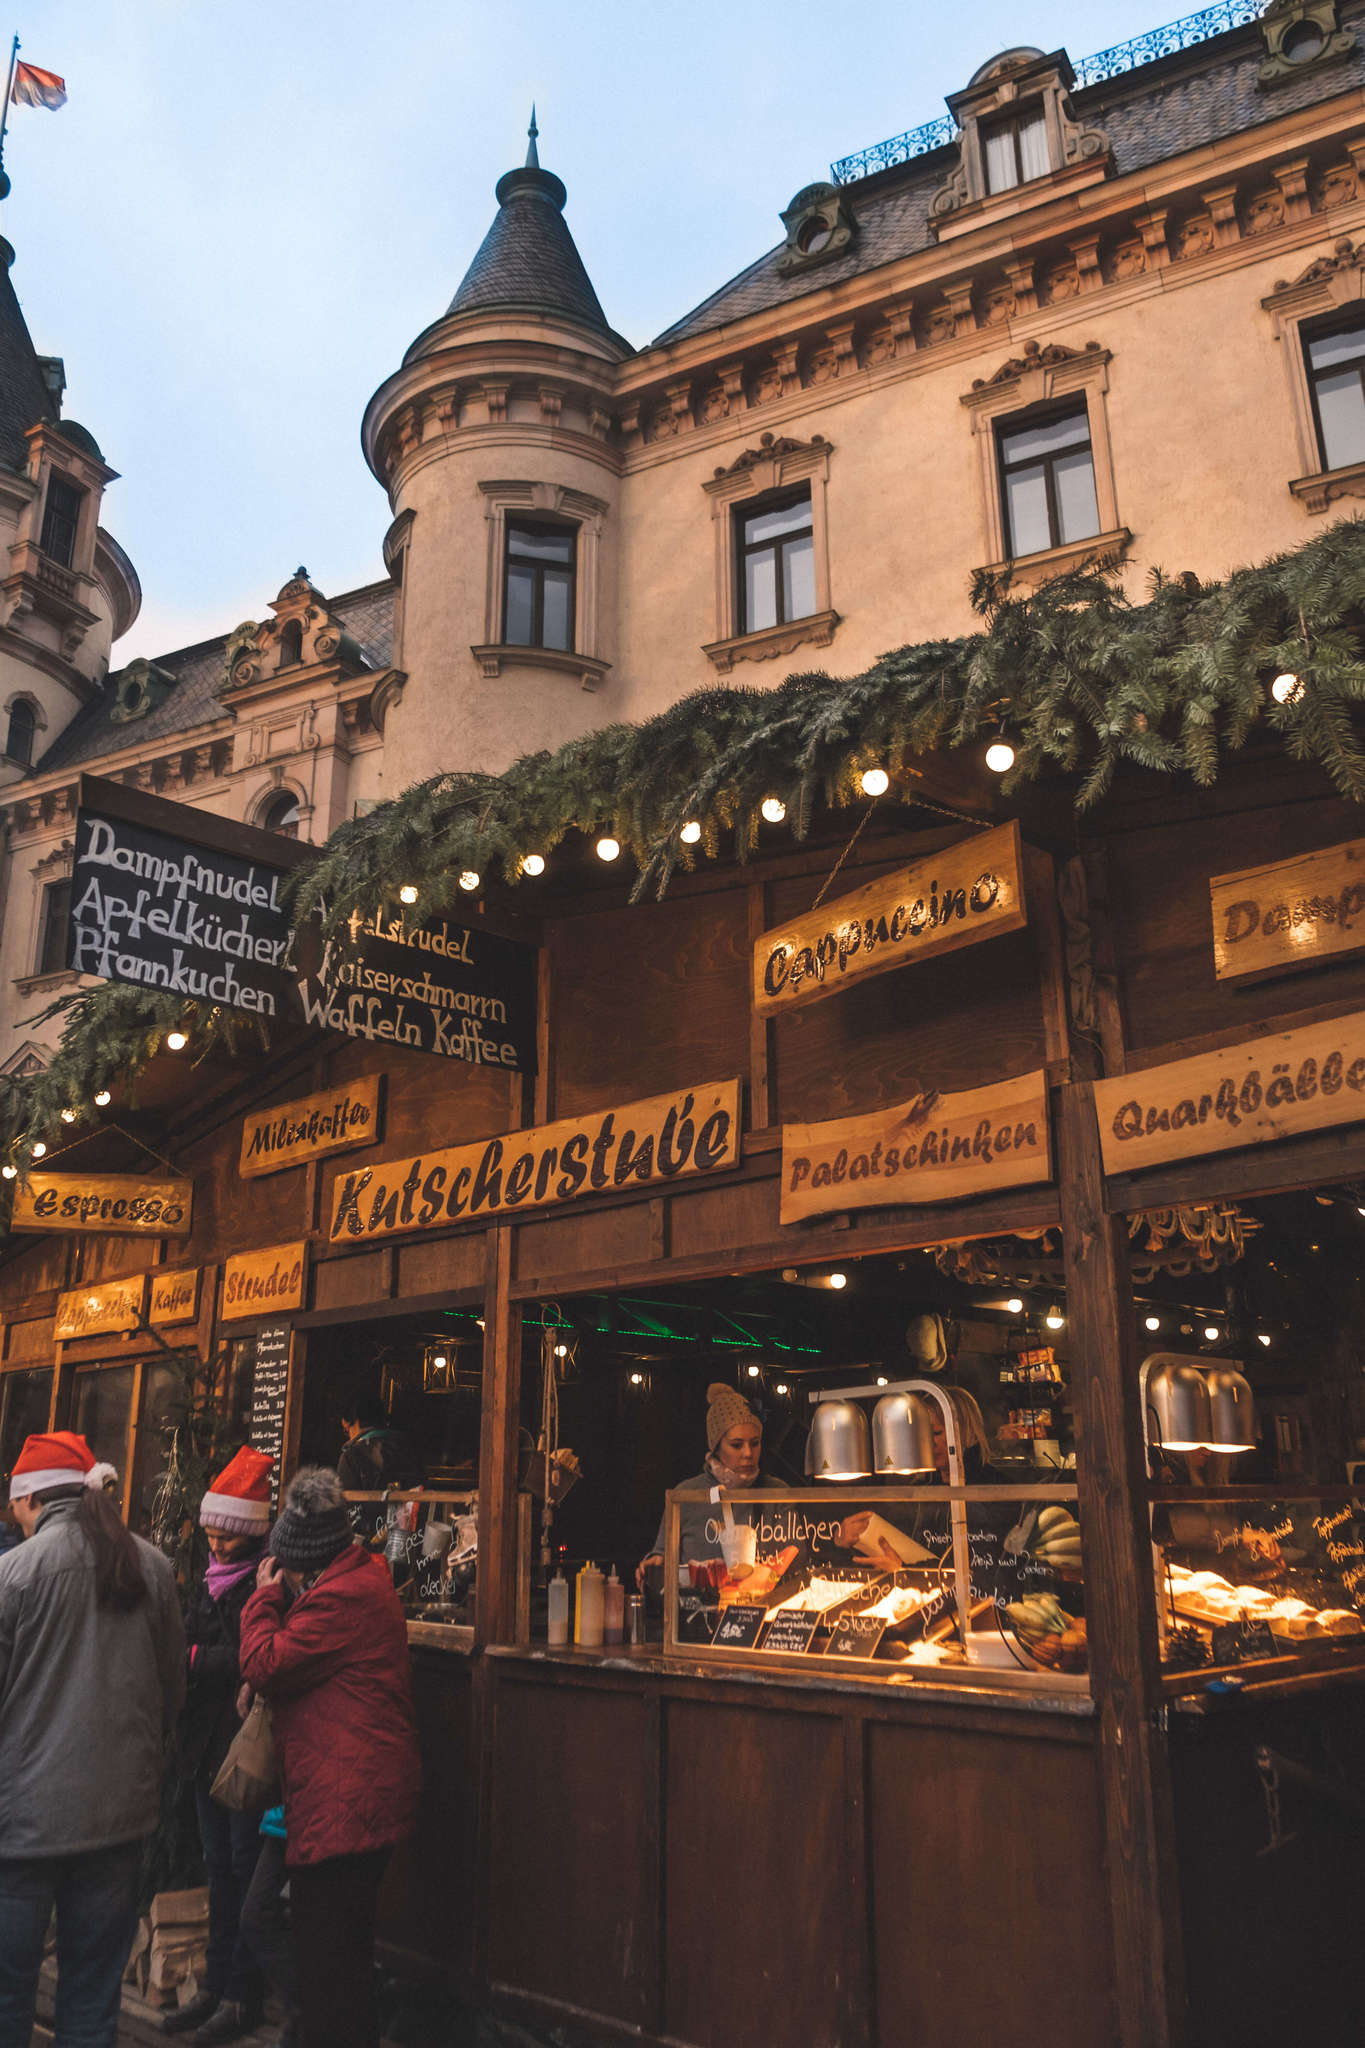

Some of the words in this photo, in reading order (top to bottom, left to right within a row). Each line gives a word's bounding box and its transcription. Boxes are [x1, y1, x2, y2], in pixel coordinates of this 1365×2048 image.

[78, 819, 282, 913] Dampfnudel
[72, 921, 276, 1016] Pfannkuchen
[763, 872, 999, 997] Cappuccino
[297, 978, 422, 1047] Waffeln
[430, 1006, 518, 1065] Kaffee
[331, 1092, 731, 1238] Kutscherstube
[790, 1117, 1038, 1193] Palatschinken
[33, 1188, 184, 1225] Espresso
[226, 1261, 301, 1304] Strudel
